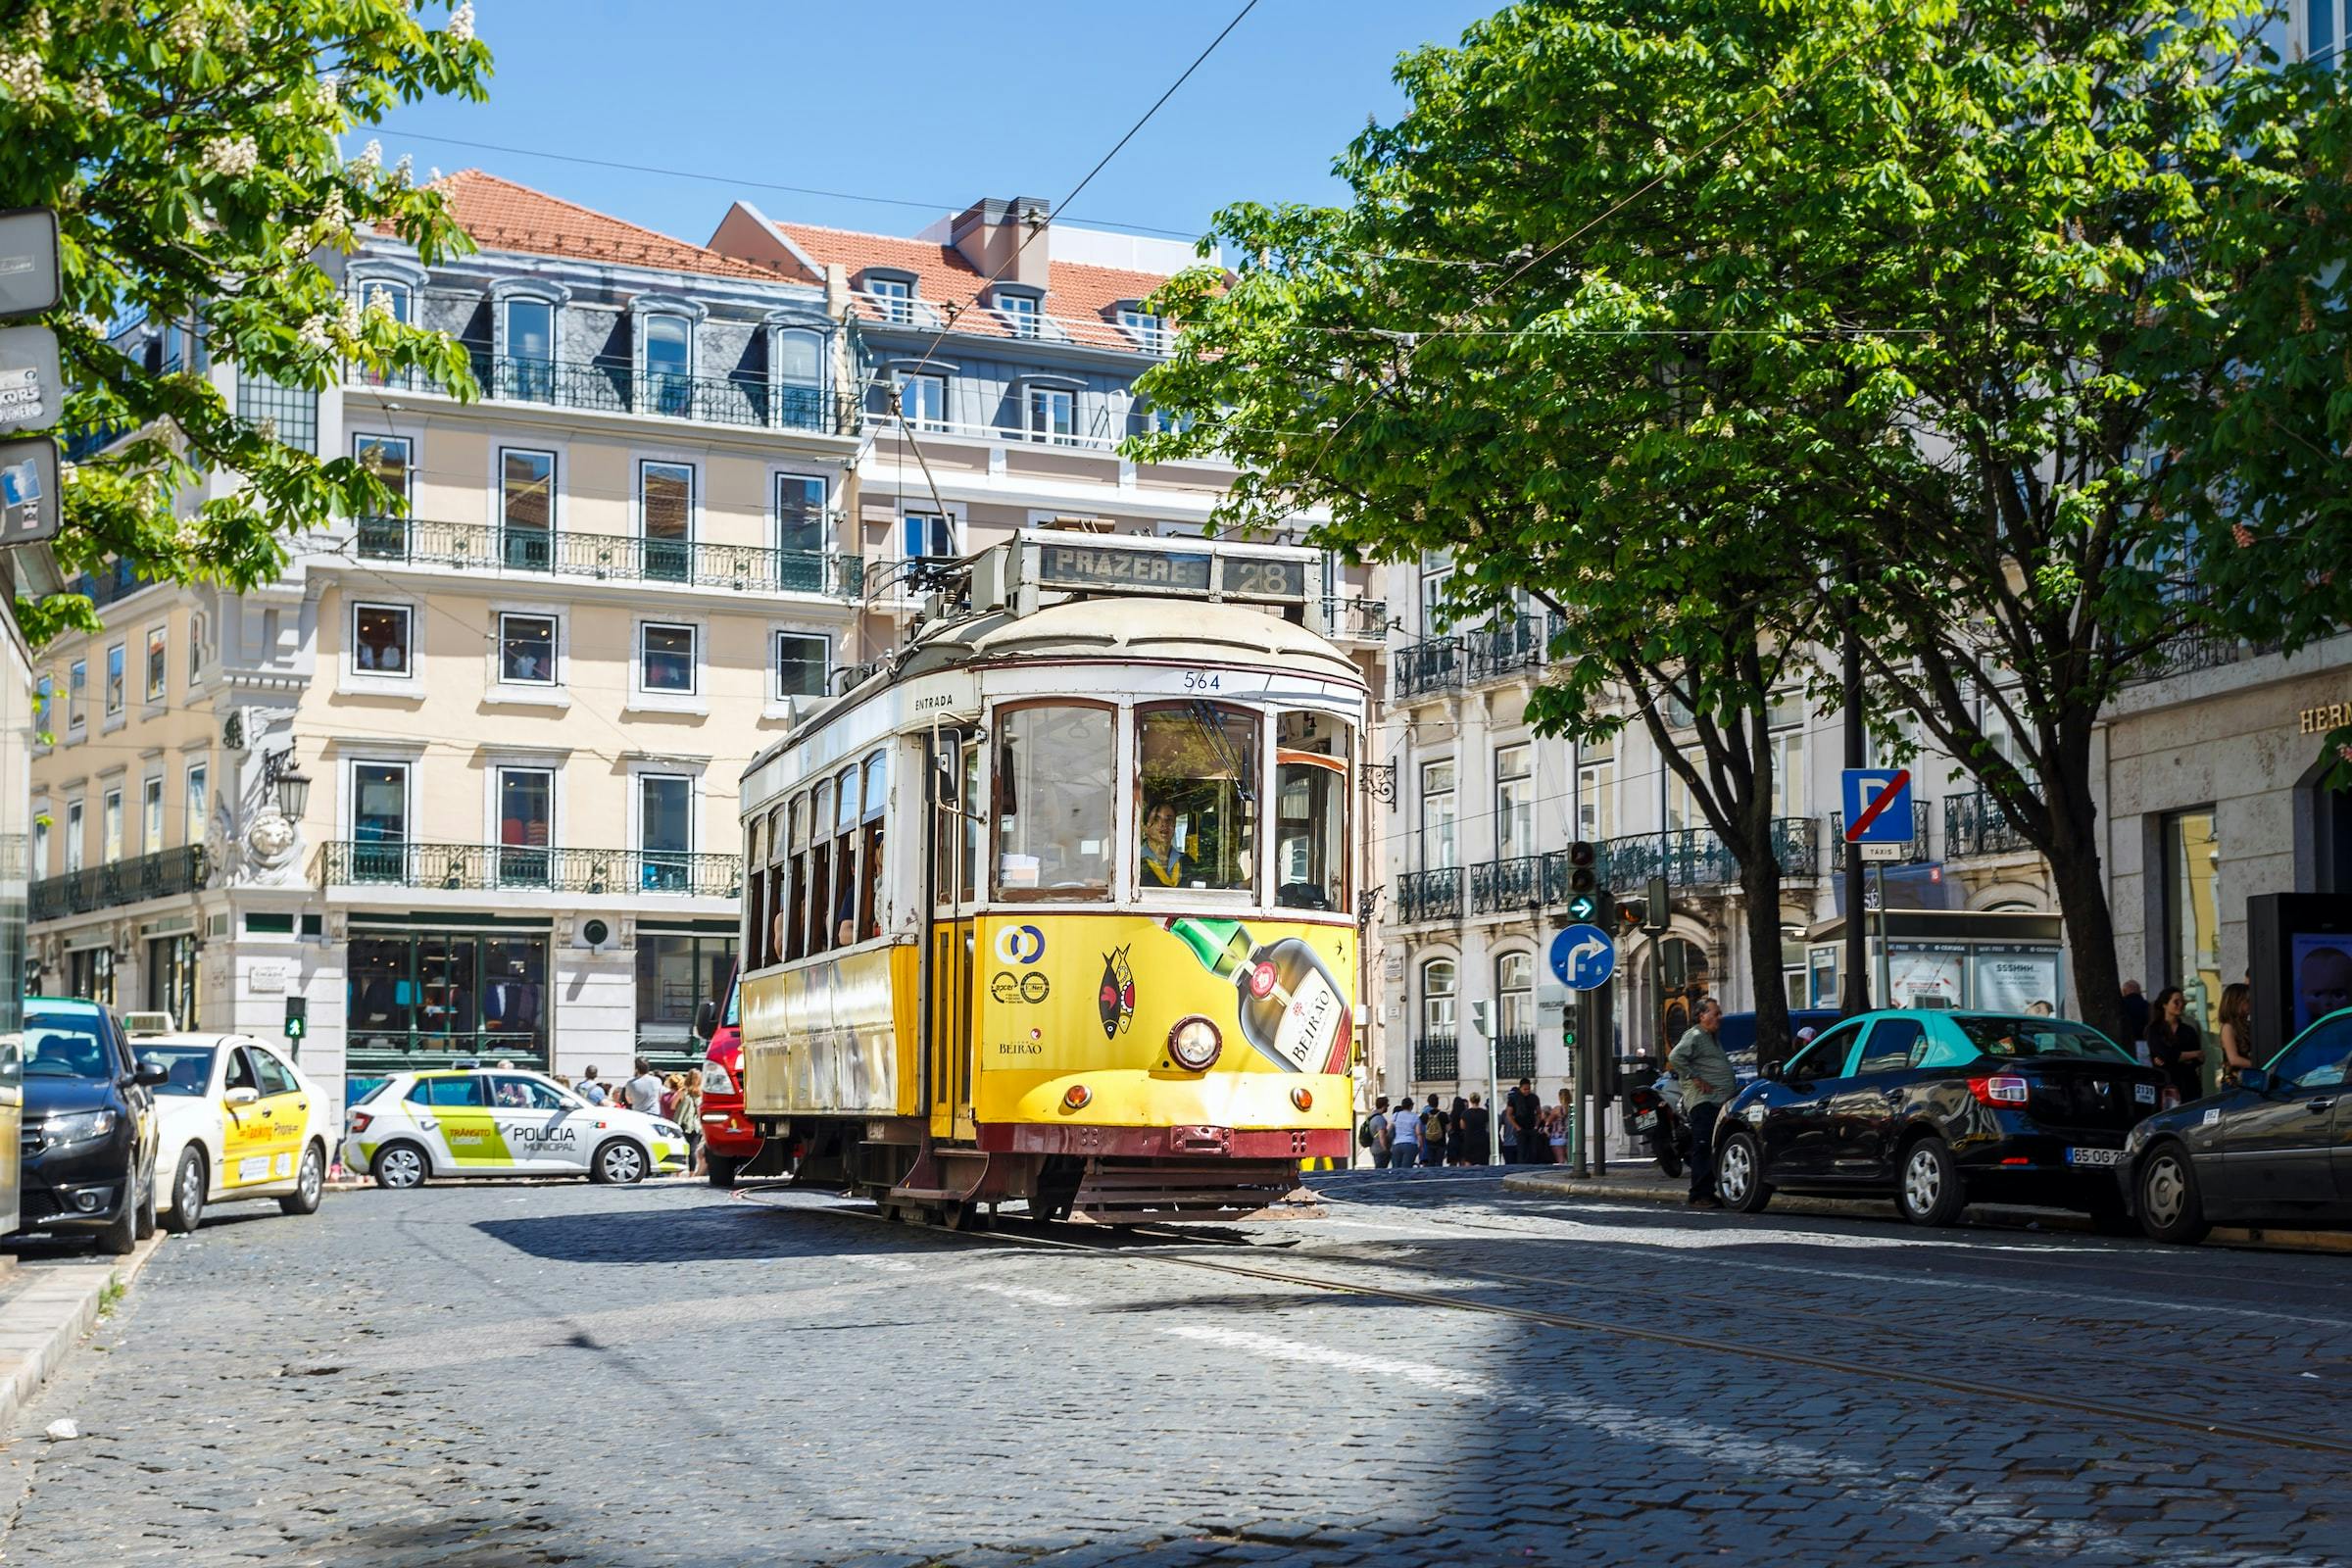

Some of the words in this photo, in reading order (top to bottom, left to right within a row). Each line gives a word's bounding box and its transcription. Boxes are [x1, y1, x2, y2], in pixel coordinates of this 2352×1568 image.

[1055, 549, 1206, 583] PRAZERES
[1238, 563, 1287, 594] 28
[1184, 671, 1221, 690] 564
[915, 694, 953, 710] ENTRADA
[1858, 777, 1896, 833] P
[999, 1043, 1043, 1055] BEIRÃO
[523, 1143, 576, 1152] MUNICIPAL
